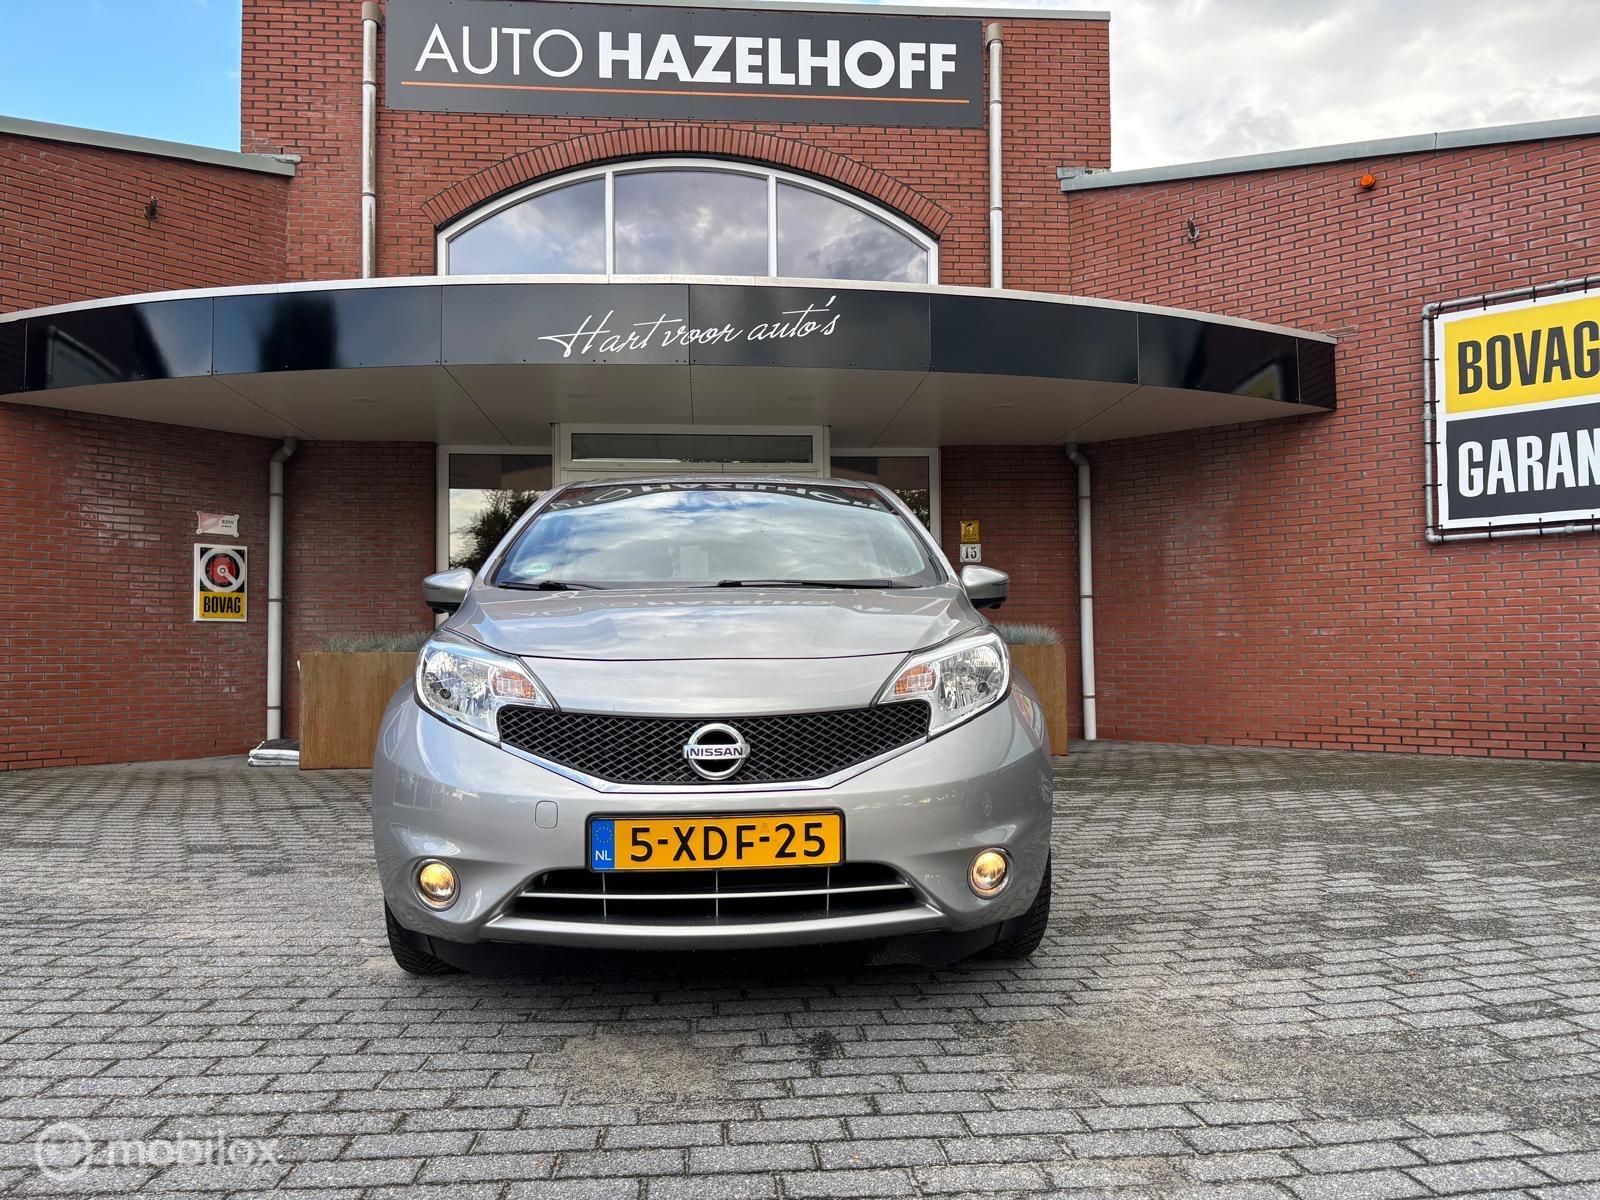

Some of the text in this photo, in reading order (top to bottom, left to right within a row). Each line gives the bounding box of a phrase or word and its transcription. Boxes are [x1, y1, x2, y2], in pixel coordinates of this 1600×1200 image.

[414, 22, 957, 91] AUTO HAZELHOFF
[537, 295, 841, 358] Hart voor auto's
[1457, 320, 1600, 395] BOVAG
[965, 546, 977, 559] 15
[203, 596, 241, 613] BOVAG
[690, 747, 744, 757] NISSAN
[595, 850, 612, 861] NL
[630, 822, 826, 863] 5-XDF-25
